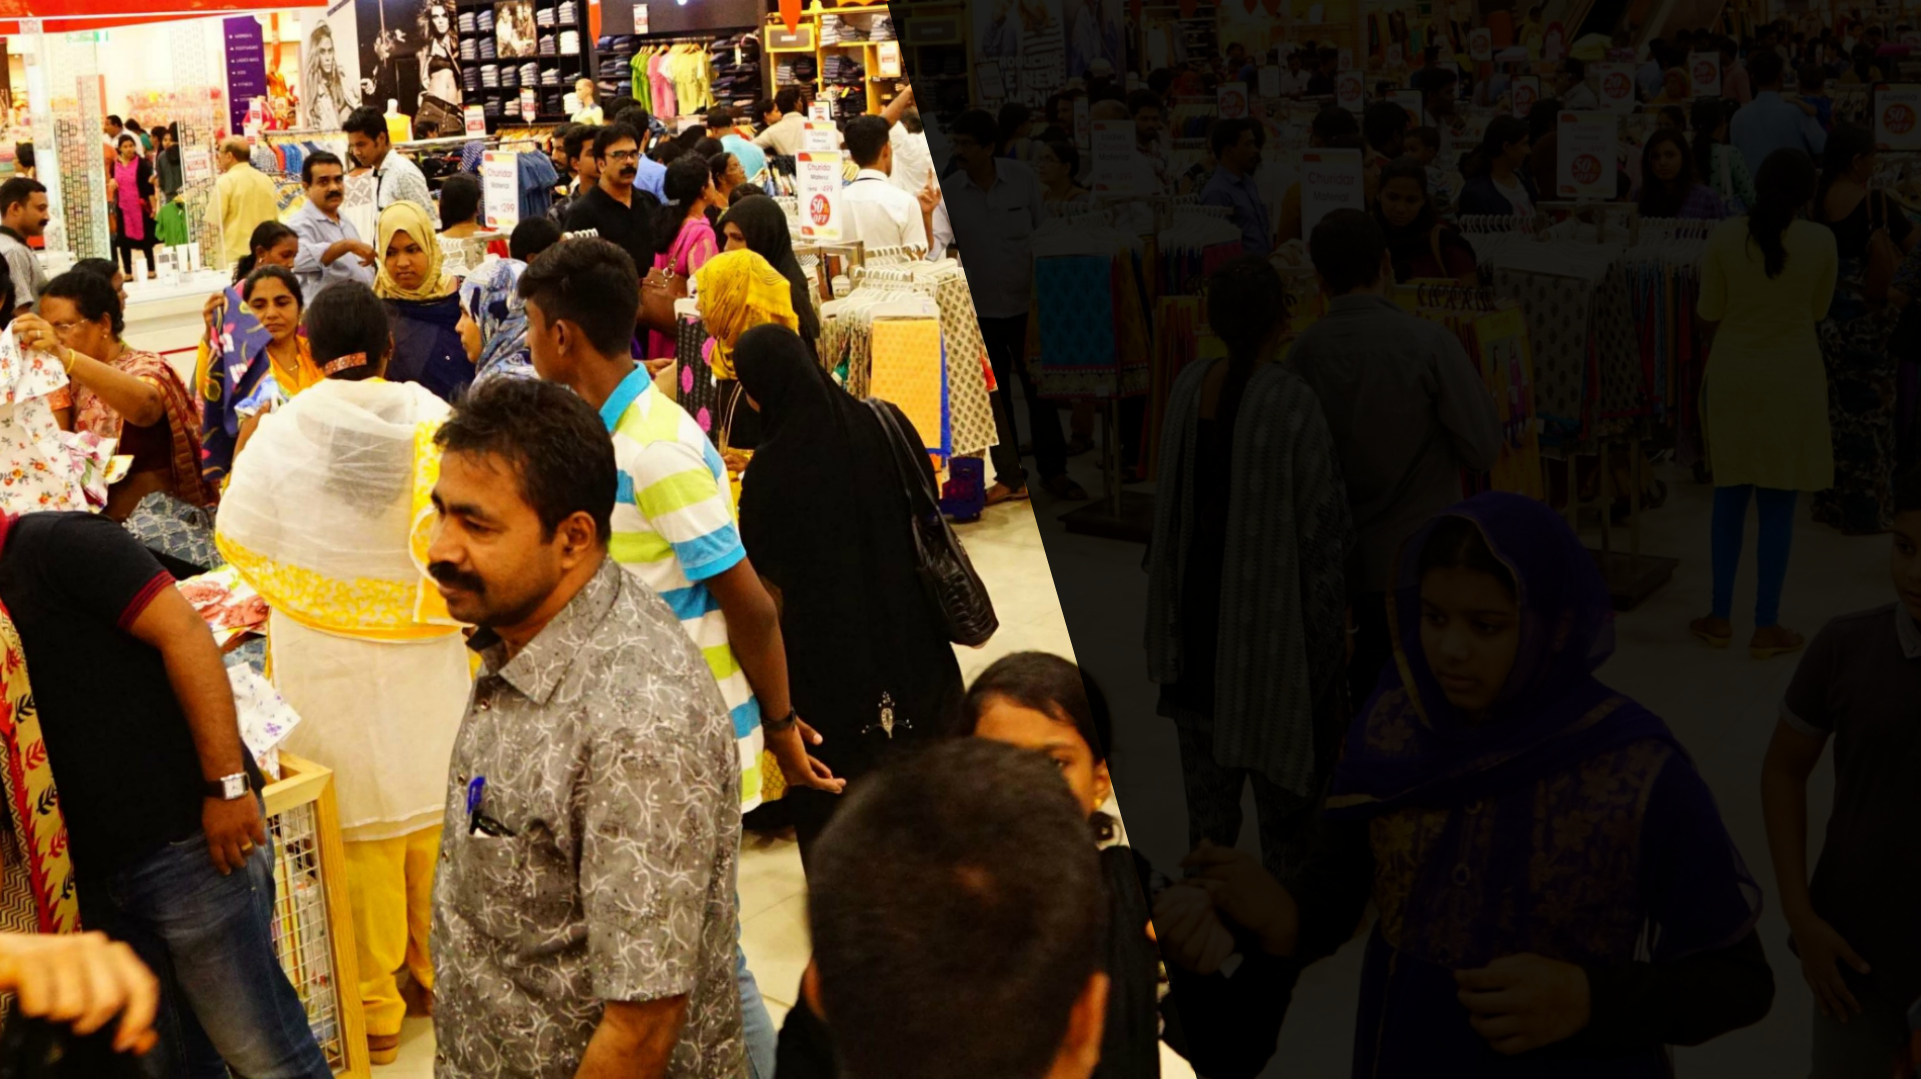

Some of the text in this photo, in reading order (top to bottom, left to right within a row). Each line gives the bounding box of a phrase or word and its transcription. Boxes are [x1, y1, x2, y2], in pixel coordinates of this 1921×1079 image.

[1022, 69, 1061, 88] NEW
[1888, 122, 1912, 132] OFF
[1101, 133, 1126, 141] Ladies
[1098, 143, 1131, 151] Churidar
[1098, 153, 1131, 161] Material
[487, 168, 513, 178] Churidar
[1575, 173, 1597, 182] OFF
[1307, 171, 1356, 185] Churidar
[1313, 191, 1349, 202] Material
[812, 214, 828, 223] OFF
